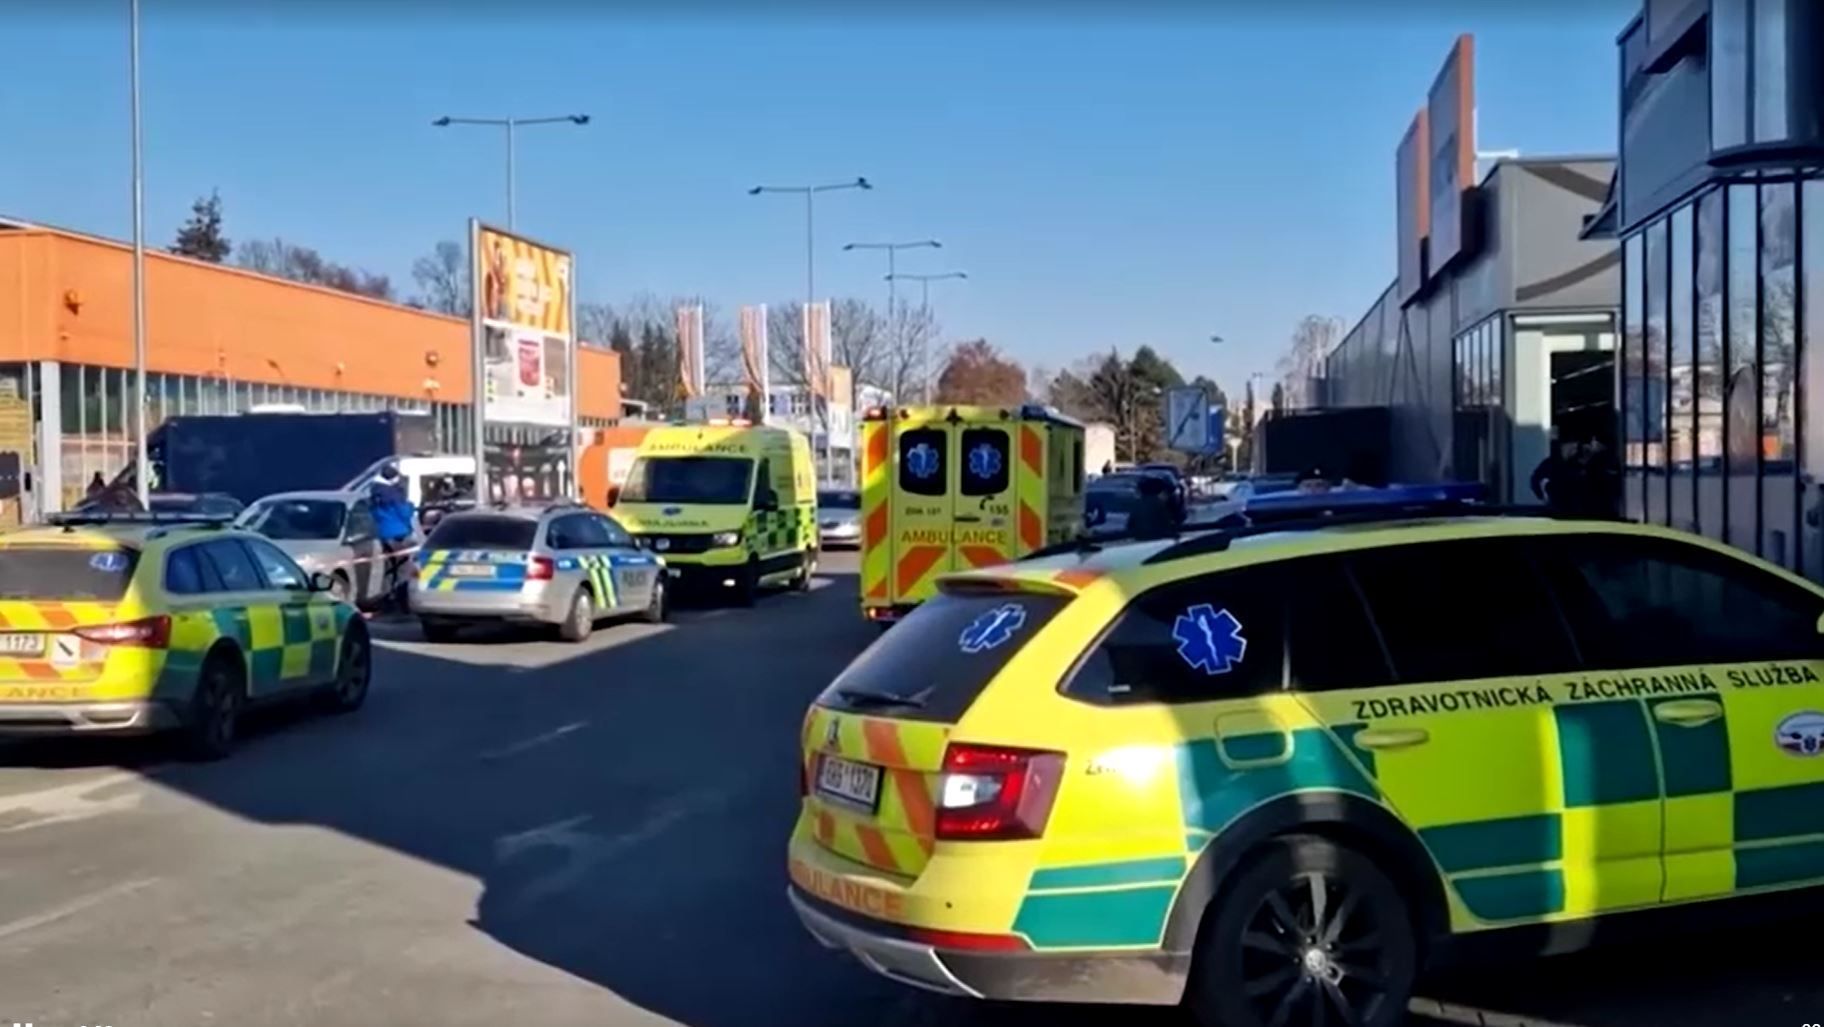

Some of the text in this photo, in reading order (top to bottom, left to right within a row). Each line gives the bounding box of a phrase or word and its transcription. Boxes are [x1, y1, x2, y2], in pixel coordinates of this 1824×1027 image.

[649, 442, 745, 453] AMBULANCE
[989, 504, 1009, 516] 155
[901, 530, 1007, 545] AMBULANCE
[1352, 663, 1820, 720] ZDRAVOTNICKÁ ZÁCHRANNÁ SLUŽBA
